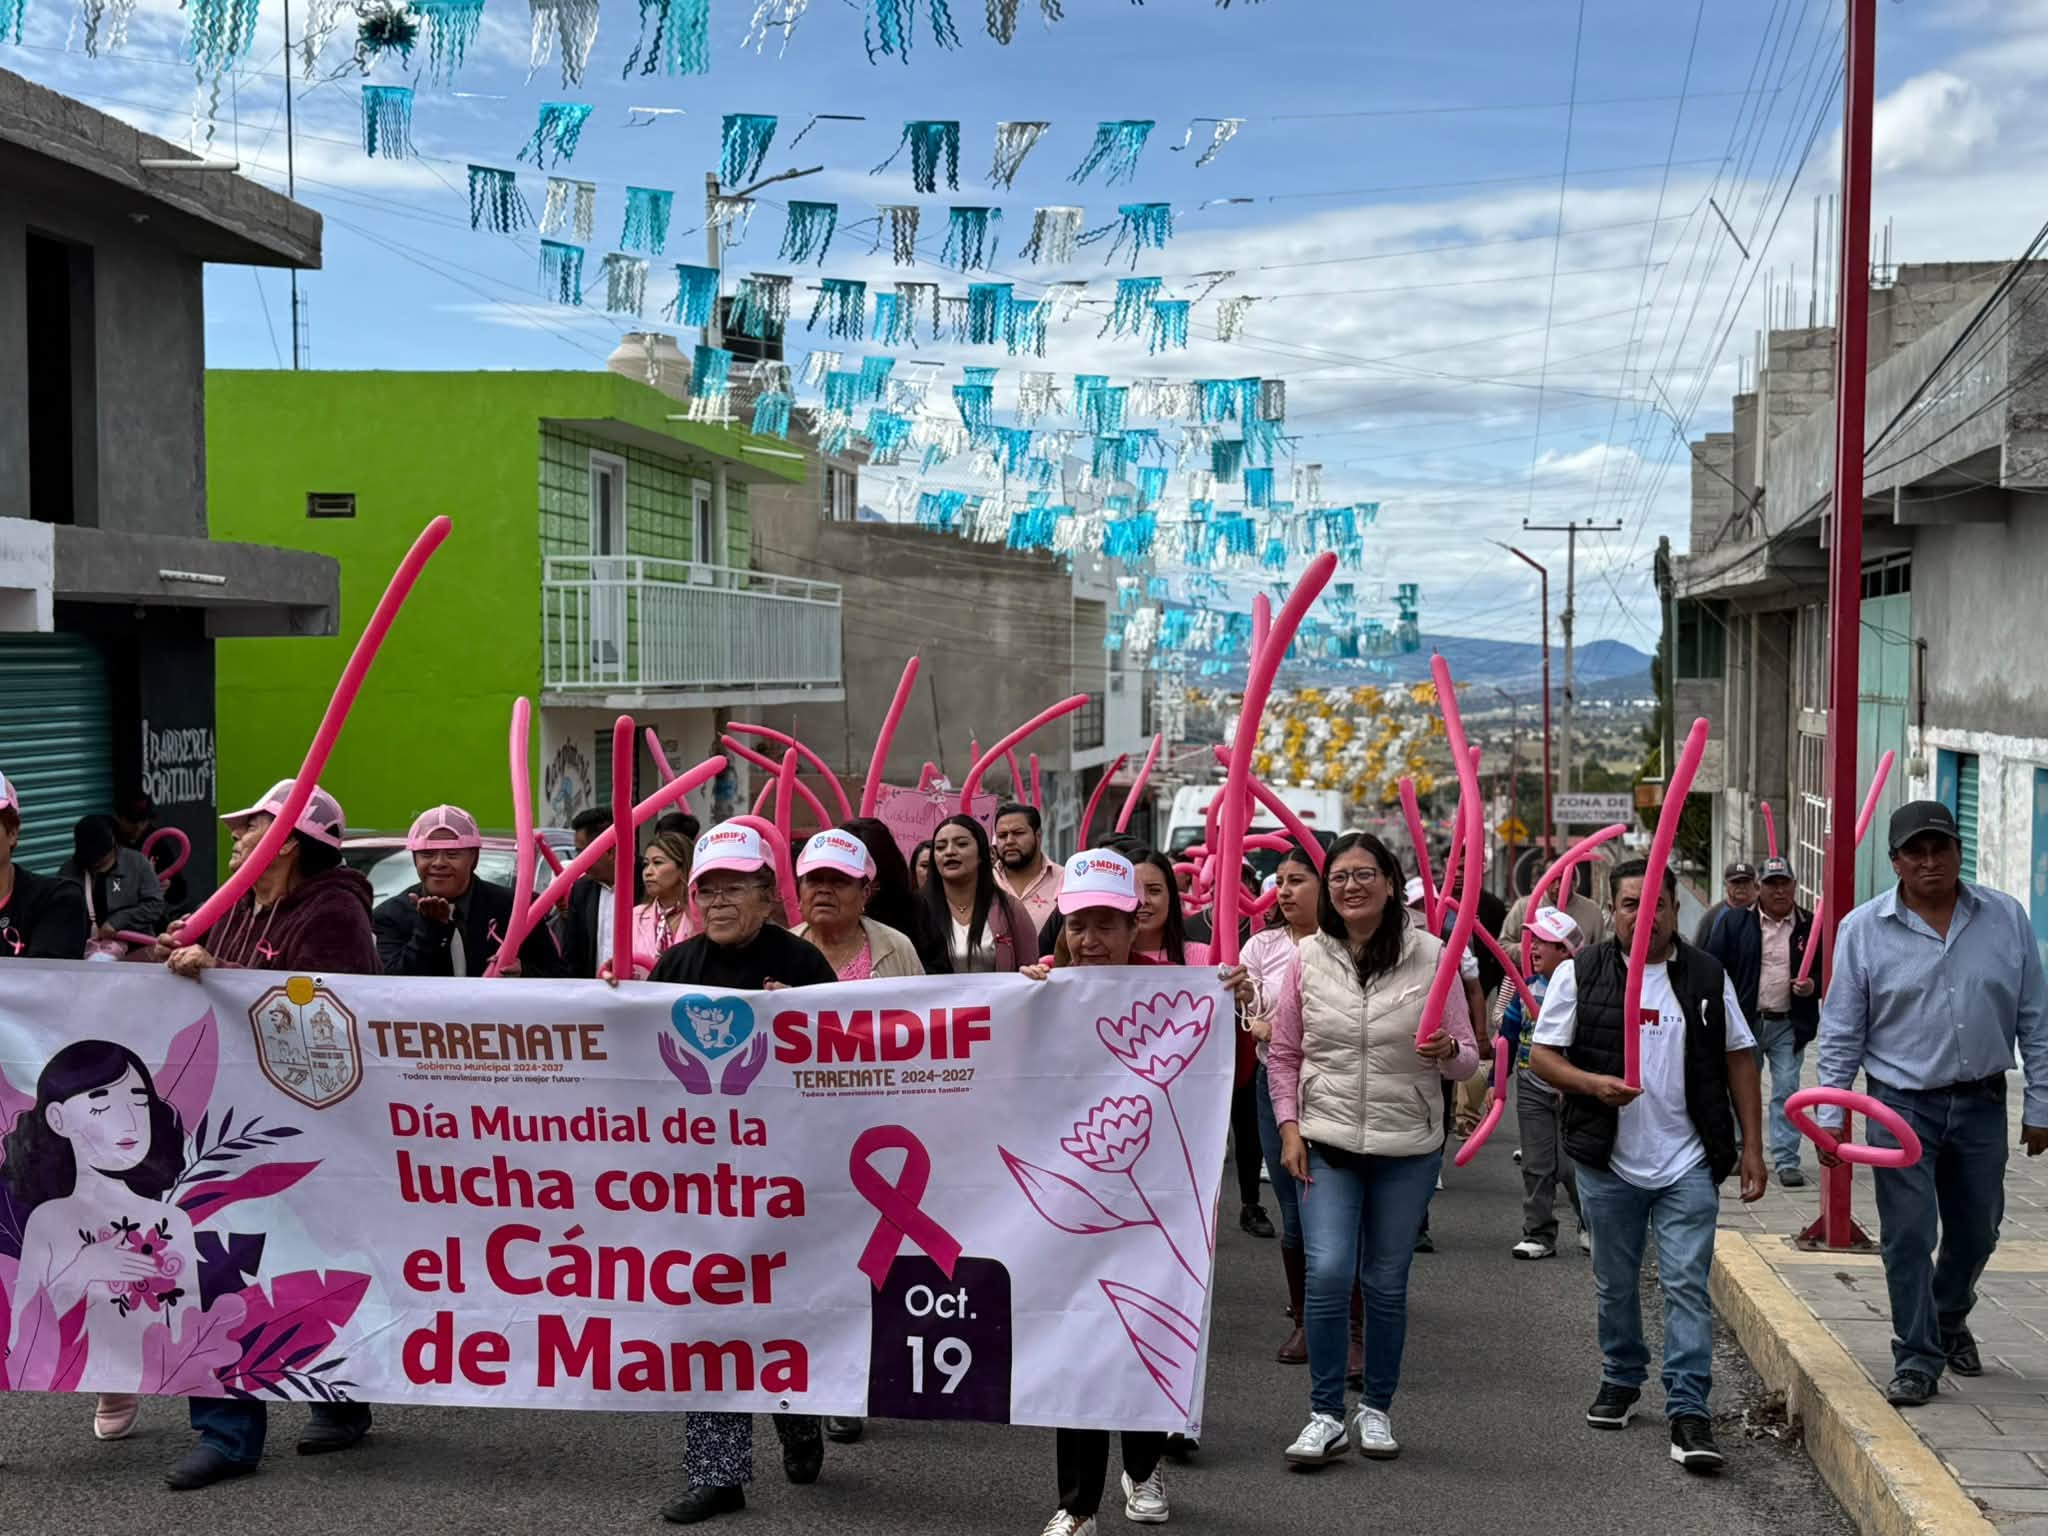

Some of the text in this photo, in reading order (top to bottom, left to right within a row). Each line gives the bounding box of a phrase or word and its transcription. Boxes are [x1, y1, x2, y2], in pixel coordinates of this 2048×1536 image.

[1556, 810, 1629, 820] REDUCTORES
[1557, 798, 1629, 808] ZONA DE
[1089, 860, 1121, 871] SMDIF
[367, 1020, 608, 1061] TERRENATE
[772, 1006, 991, 1064] SMDIF
[402, 1073, 429, 1081] Todos
[430, 1073, 442, 1081] en
[443, 1073, 492, 1082] movimiento
[494, 1076, 509, 1084] por
[525, 1075, 550, 1084] mejor
[552, 1075, 581, 1083] futuro
[416, 1061, 462, 1072] Gobierno
[464, 1062, 511, 1074] Municipal
[792, 1068, 975, 1089] TERRENATE 2024-2027
[886, 1089, 900, 1097] por
[390, 1102, 768, 1146] Día Mundial de la
[397, 1150, 806, 1218] lucha contra
[403, 1224, 787, 1305] el Cáncer
[905, 1284, 977, 1319] Oct.
[402, 1311, 809, 1394] de Mama
[907, 1336, 972, 1393] 19
